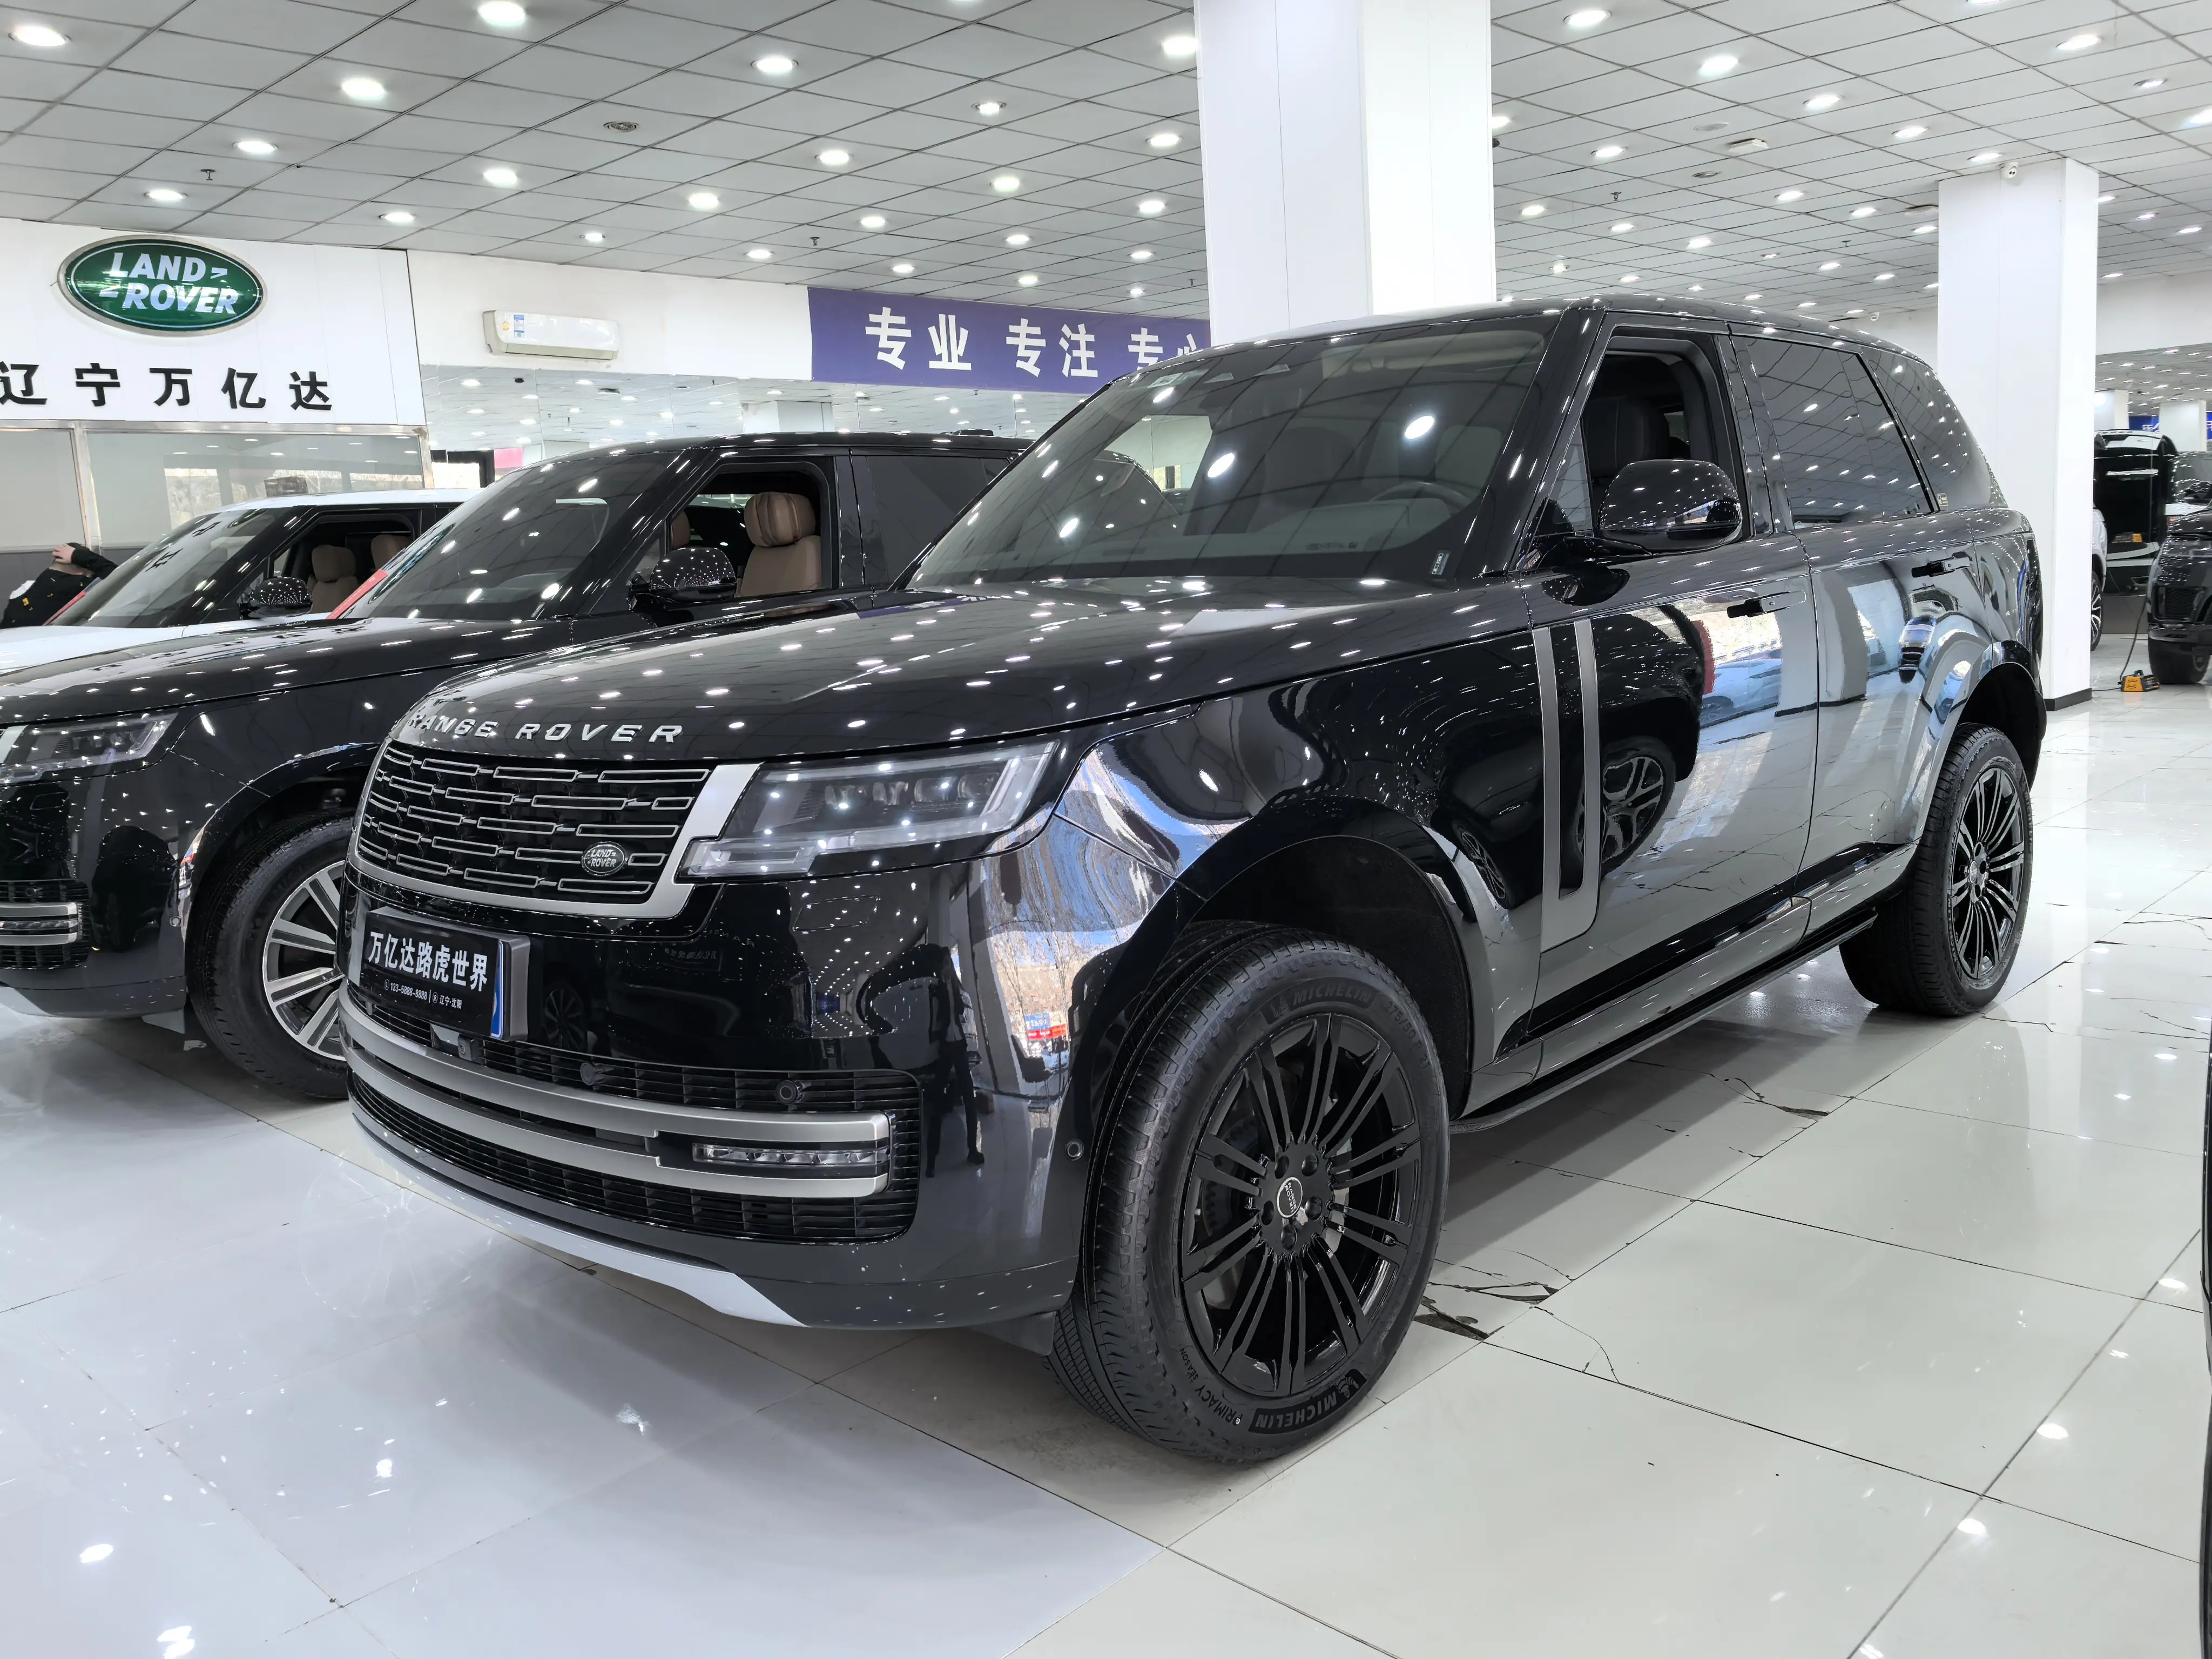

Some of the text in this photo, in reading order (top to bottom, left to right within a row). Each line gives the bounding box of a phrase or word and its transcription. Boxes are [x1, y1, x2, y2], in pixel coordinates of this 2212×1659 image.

[110, 251, 211, 282] LAND
[122, 282, 239, 315] ROVER
[865, 307, 972, 370] 专业
[1006, 319, 1098, 378] 专注
[0, 361, 333, 411] 辽宁万亿达
[407, 713, 684, 744] RANGE ROVER
[590, 848, 613, 858] LAND
[590, 858, 617, 867] ROVER
[368, 930, 488, 992] 万亿达路虎世界
[390, 982, 428, 1000] 133-5888-8888
[1293, 981, 1372, 1006] MICHELIN
[1384, 1000, 1417, 1039] 275/50
[1284, 1184, 1294, 1213] ROVER
[1287, 1182, 1297, 1211] RANGE
[1179, 1347, 1199, 1381] SEASON
[1194, 1384, 1243, 1426] PRIMACY
[1254, 1392, 1338, 1429] MICHELIN
